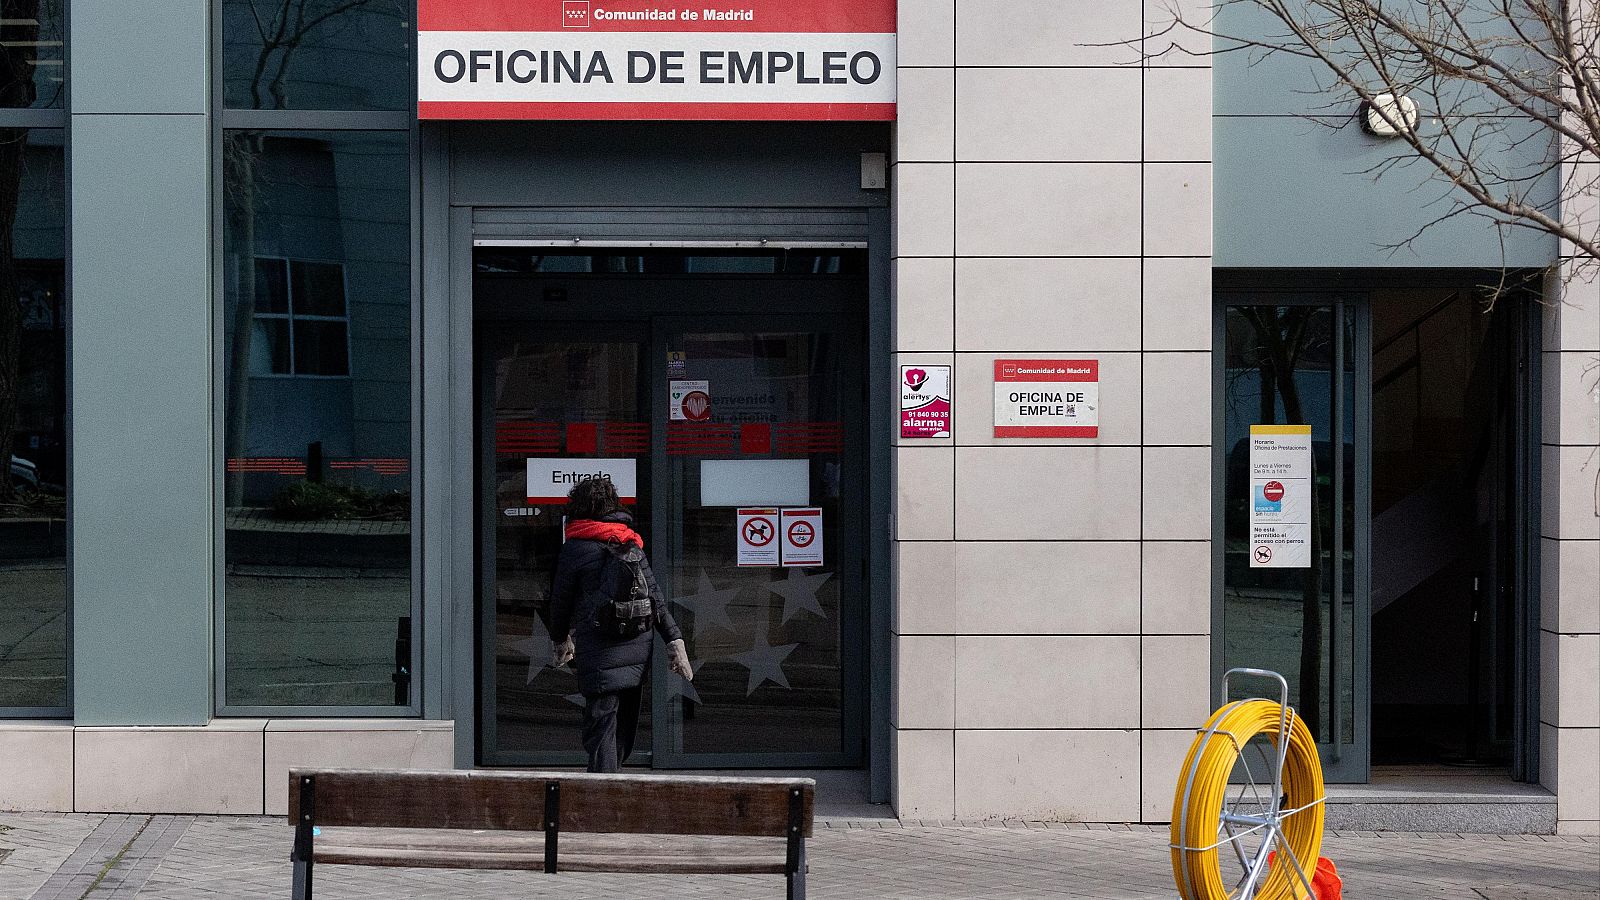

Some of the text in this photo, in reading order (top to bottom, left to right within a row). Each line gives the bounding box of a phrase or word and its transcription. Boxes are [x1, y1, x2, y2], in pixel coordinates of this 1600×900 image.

[593, 8, 754, 21] Comunidad de Madrid
[433, 50, 882, 85] OFICINA DE EMPLEO
[903, 393, 930, 401] alertys
[1009, 392, 1084, 403] OFICINA DE
[1019, 405, 1074, 416] EMPLE
[903, 418, 945, 427] alarma
